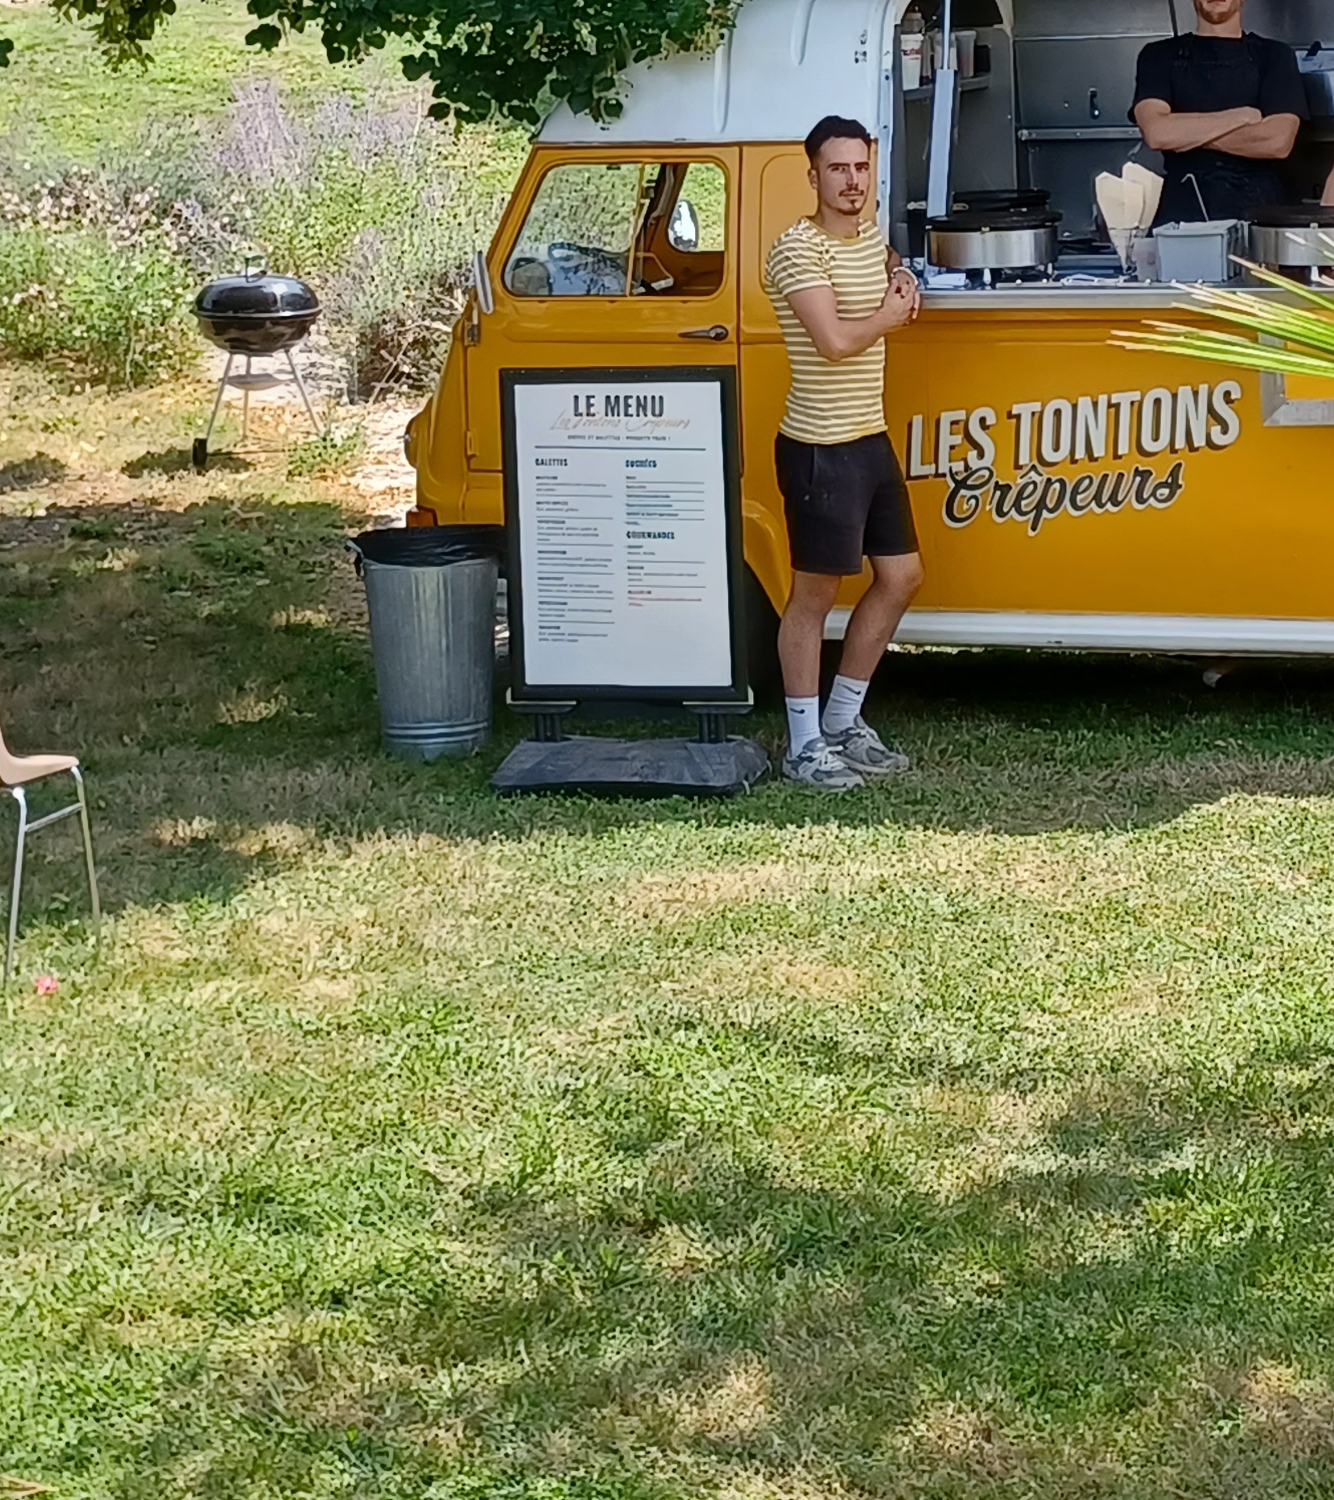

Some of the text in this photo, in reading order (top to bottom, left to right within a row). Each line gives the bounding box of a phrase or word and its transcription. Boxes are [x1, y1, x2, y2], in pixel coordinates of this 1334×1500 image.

[573, 394, 664, 418] LE MENU
[907, 380, 1242, 481] LES TONTONS
[942, 460, 1185, 536] Crêpeurs
